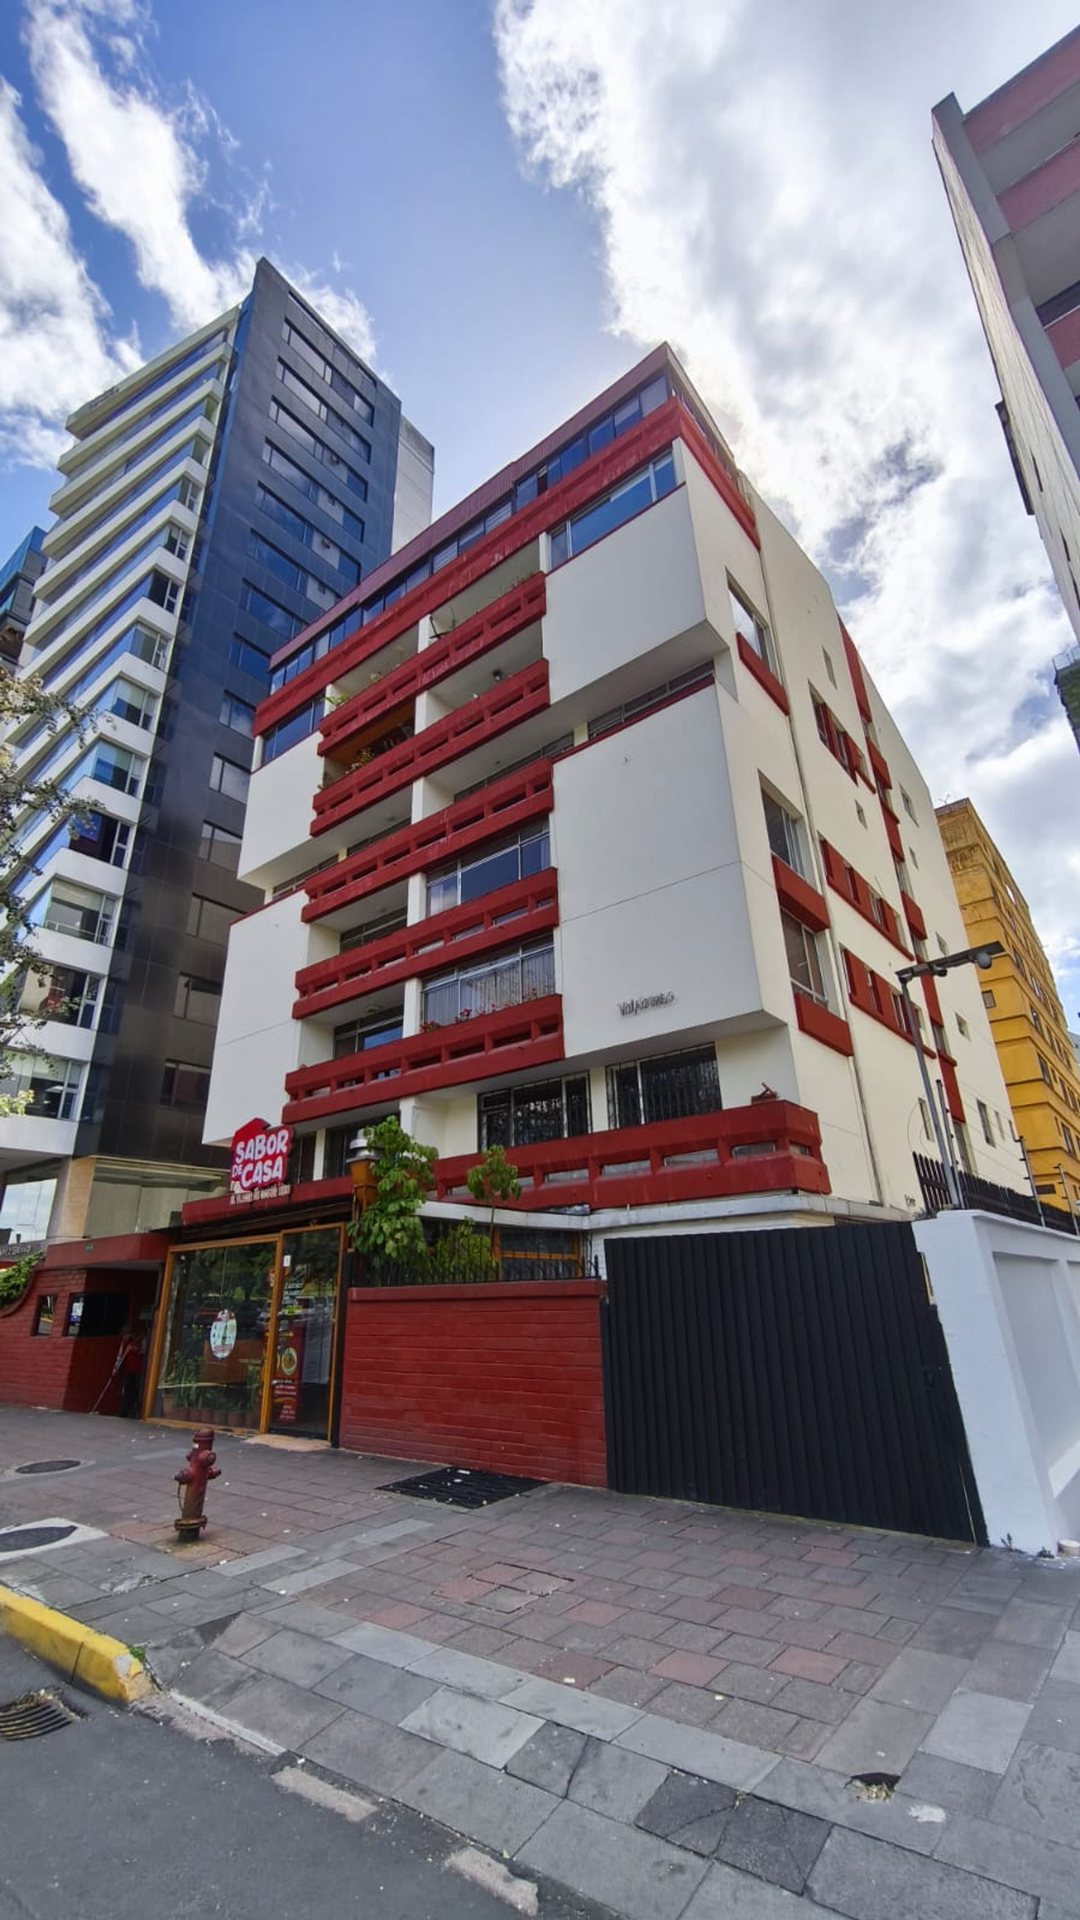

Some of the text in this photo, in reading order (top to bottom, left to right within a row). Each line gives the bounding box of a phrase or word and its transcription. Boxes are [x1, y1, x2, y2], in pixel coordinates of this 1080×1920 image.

[235, 1128, 289, 1164] SABOR
[231, 1156, 283, 1188] DE CASA
